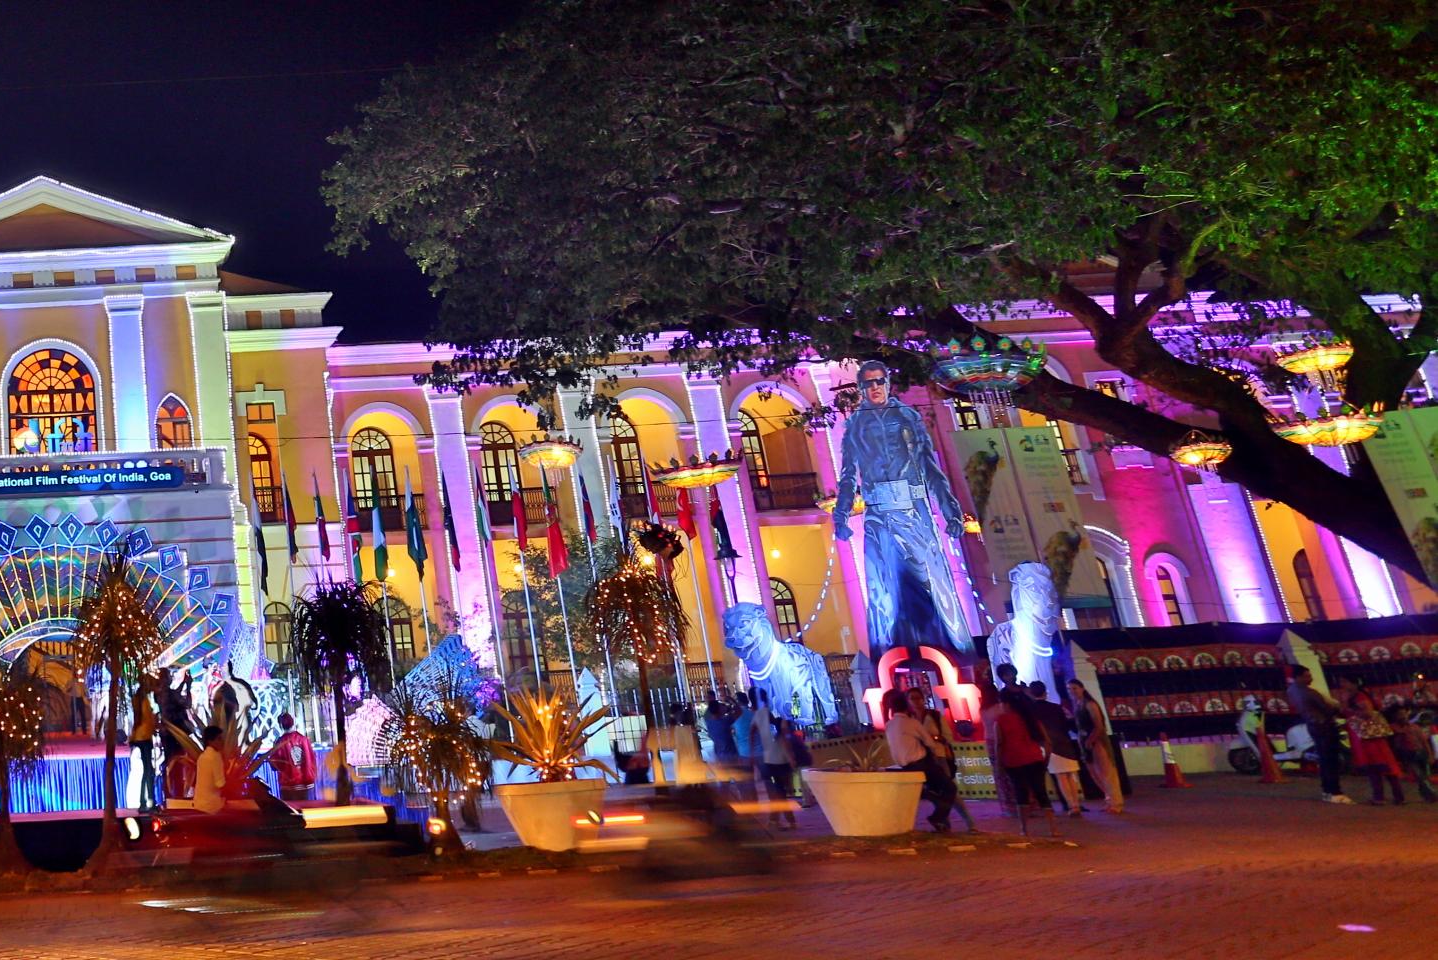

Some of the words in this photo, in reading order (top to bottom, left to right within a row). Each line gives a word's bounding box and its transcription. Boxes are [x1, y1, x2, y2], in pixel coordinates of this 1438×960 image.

[35, 476, 59, 486] Film
[60, 474, 101, 485] Festival
[103, 473, 116, 483] Of
[118, 472, 148, 483] India,
[149, 471, 172, 481] Goa
[956, 773, 995, 784] Festiva
